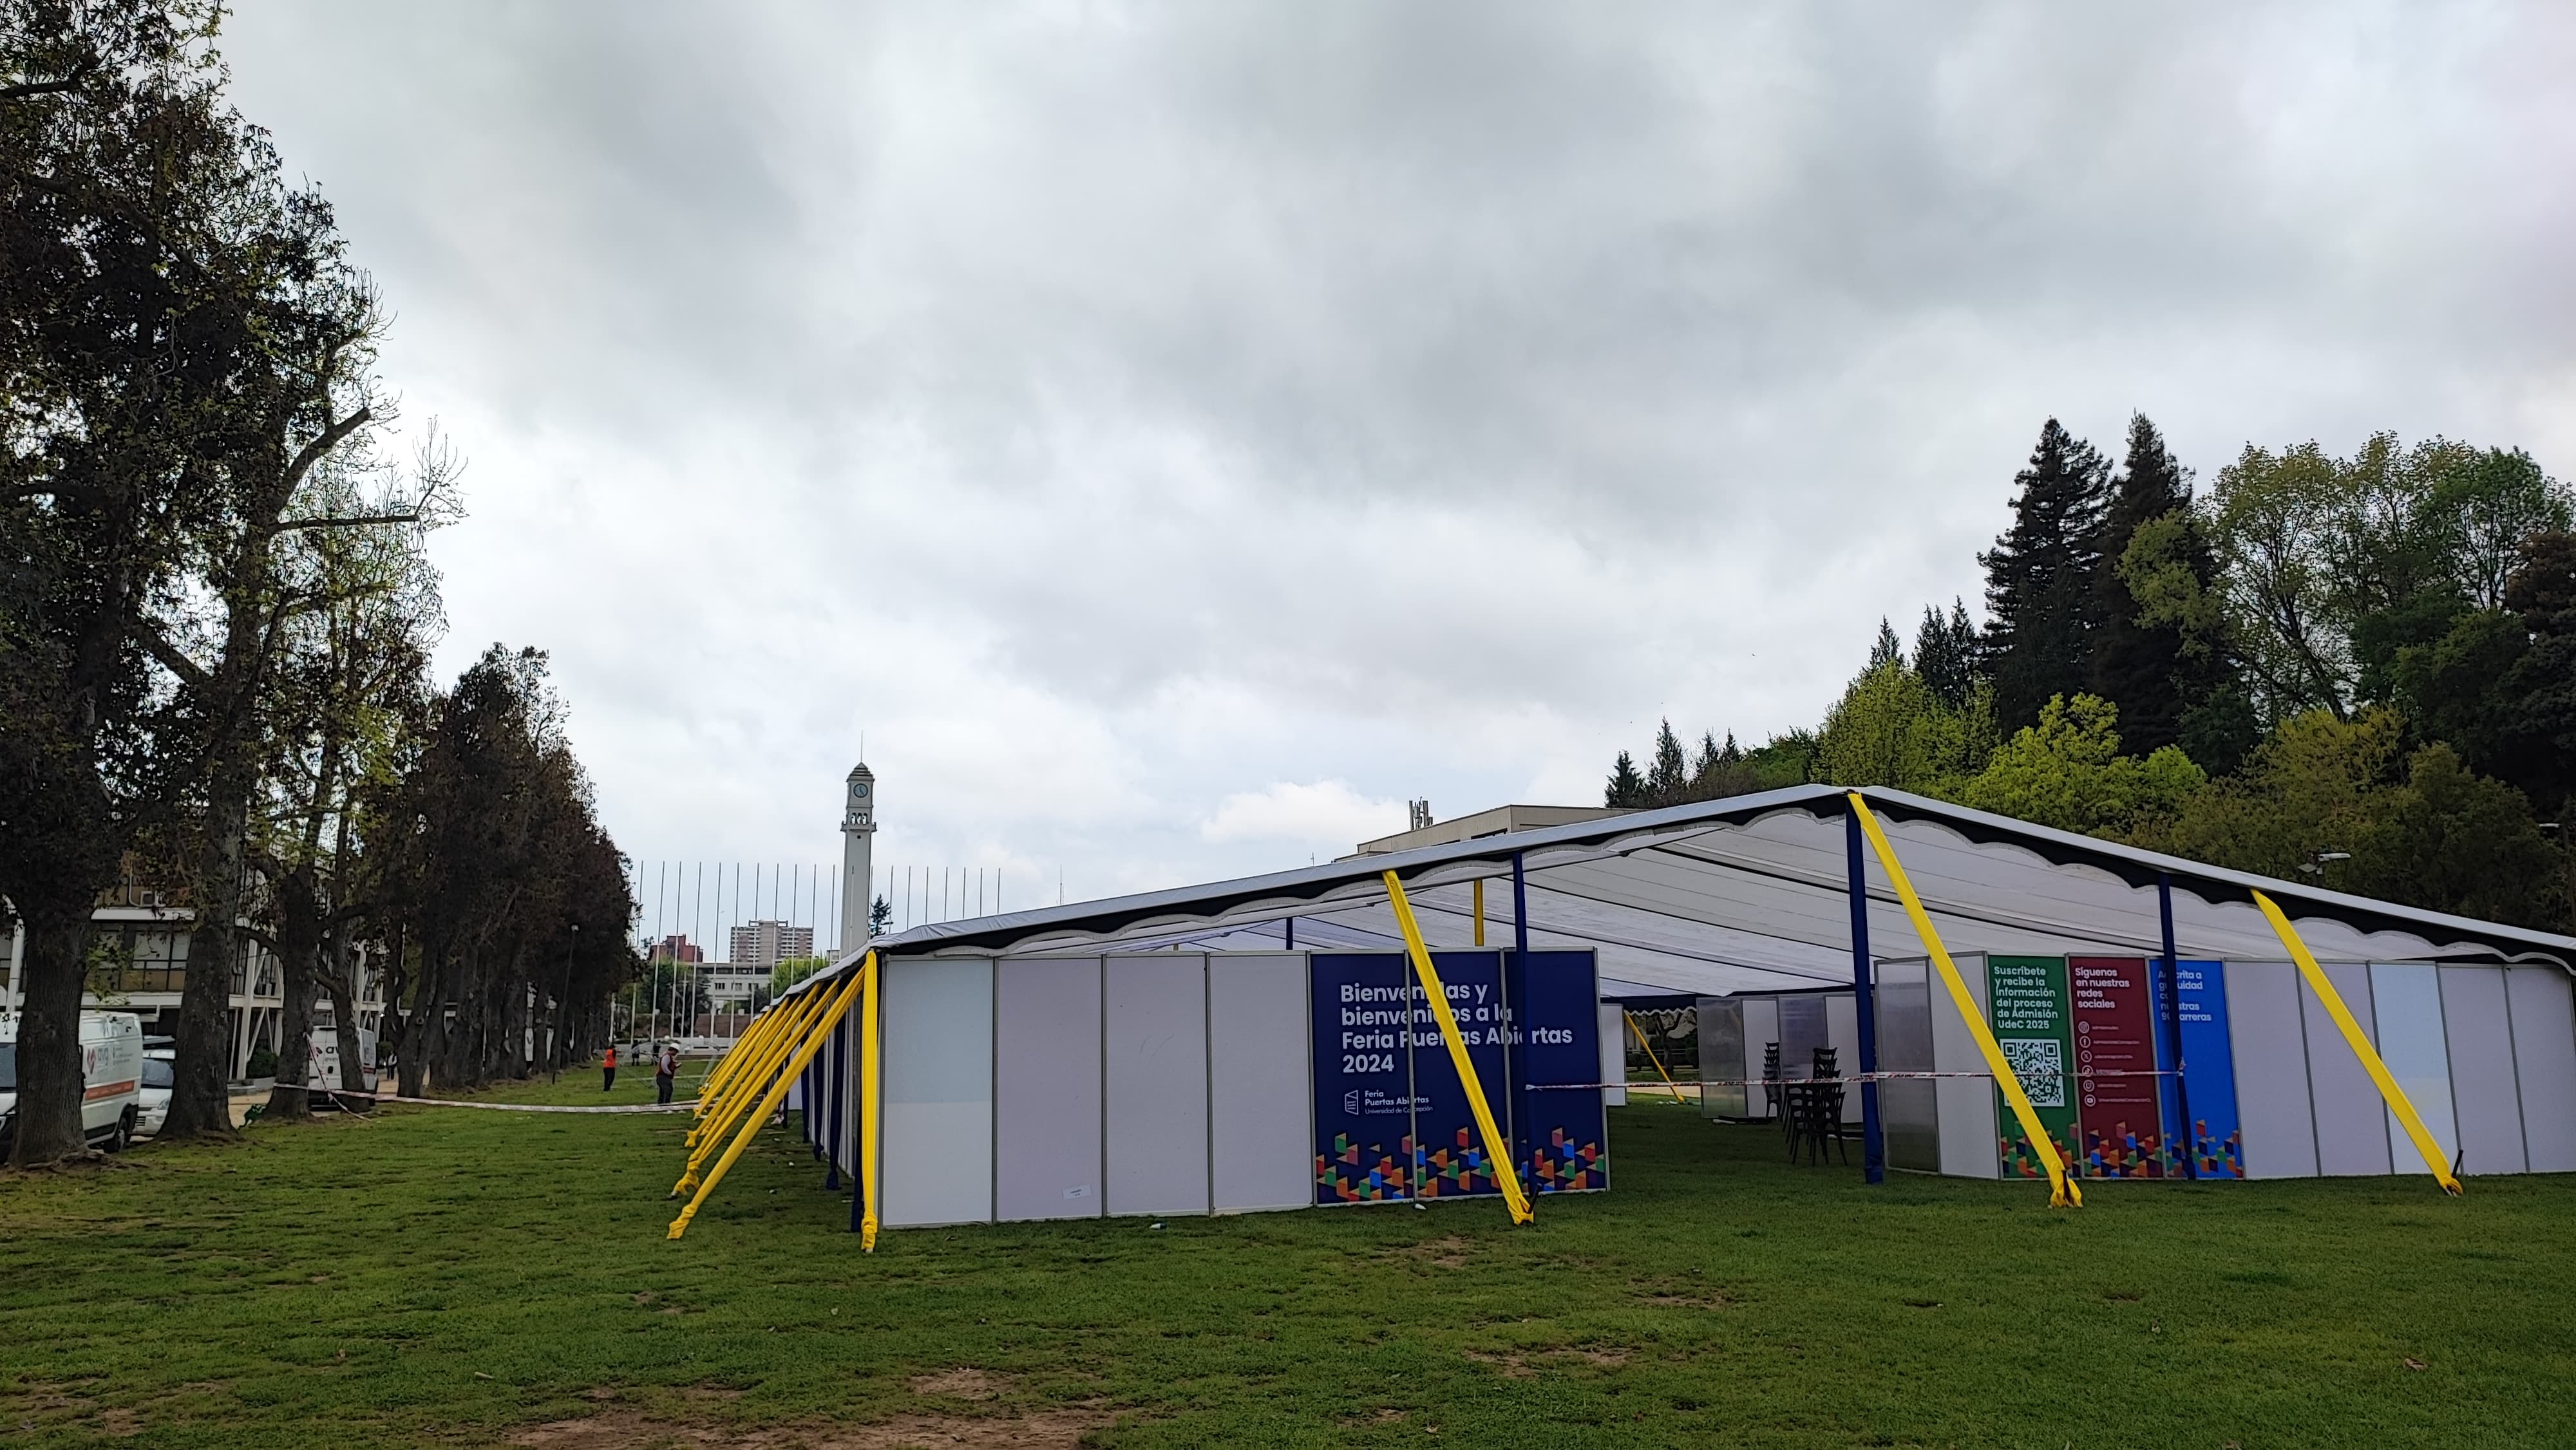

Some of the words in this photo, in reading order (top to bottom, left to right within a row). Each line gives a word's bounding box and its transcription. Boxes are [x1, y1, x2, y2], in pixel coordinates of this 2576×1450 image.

[1994, 965, 2046, 975] Suscríbete
[2075, 966, 2117, 979] Síguenos
[1994, 978, 2001, 990] y
[2003, 976, 2034, 986] recibe
[2036, 977, 2045, 986] la
[2089, 978, 2130, 988] nuestras
[1341, 982, 1470, 1002] Bienvenas
[1474, 984, 1488, 1004] y
[2077, 988, 2103, 998] redes
[1996, 998, 2012, 1008] del
[2013, 999, 2053, 1011] proceso
[2078, 999, 2116, 1009] sociales
[1341, 1004, 1471, 1026] bienvenios
[1475, 1008, 1489, 1022] a
[1494, 1003, 1513, 1022] la
[1997, 1009, 2009, 1018] de
[2011, 1009, 2058, 1019] Admisión
[1998, 1019, 2024, 1029] UdeC
[2025, 1020, 2050, 1030] 2025
[1342, 1029, 1394, 1050] Feria
[1399, 1030, 1481, 1048] Pueras
[1343, 1054, 1394, 1073] 2024
[1365, 1089, 1384, 1098] Feria
[1396, 1097, 1429, 1105] Abirtas
